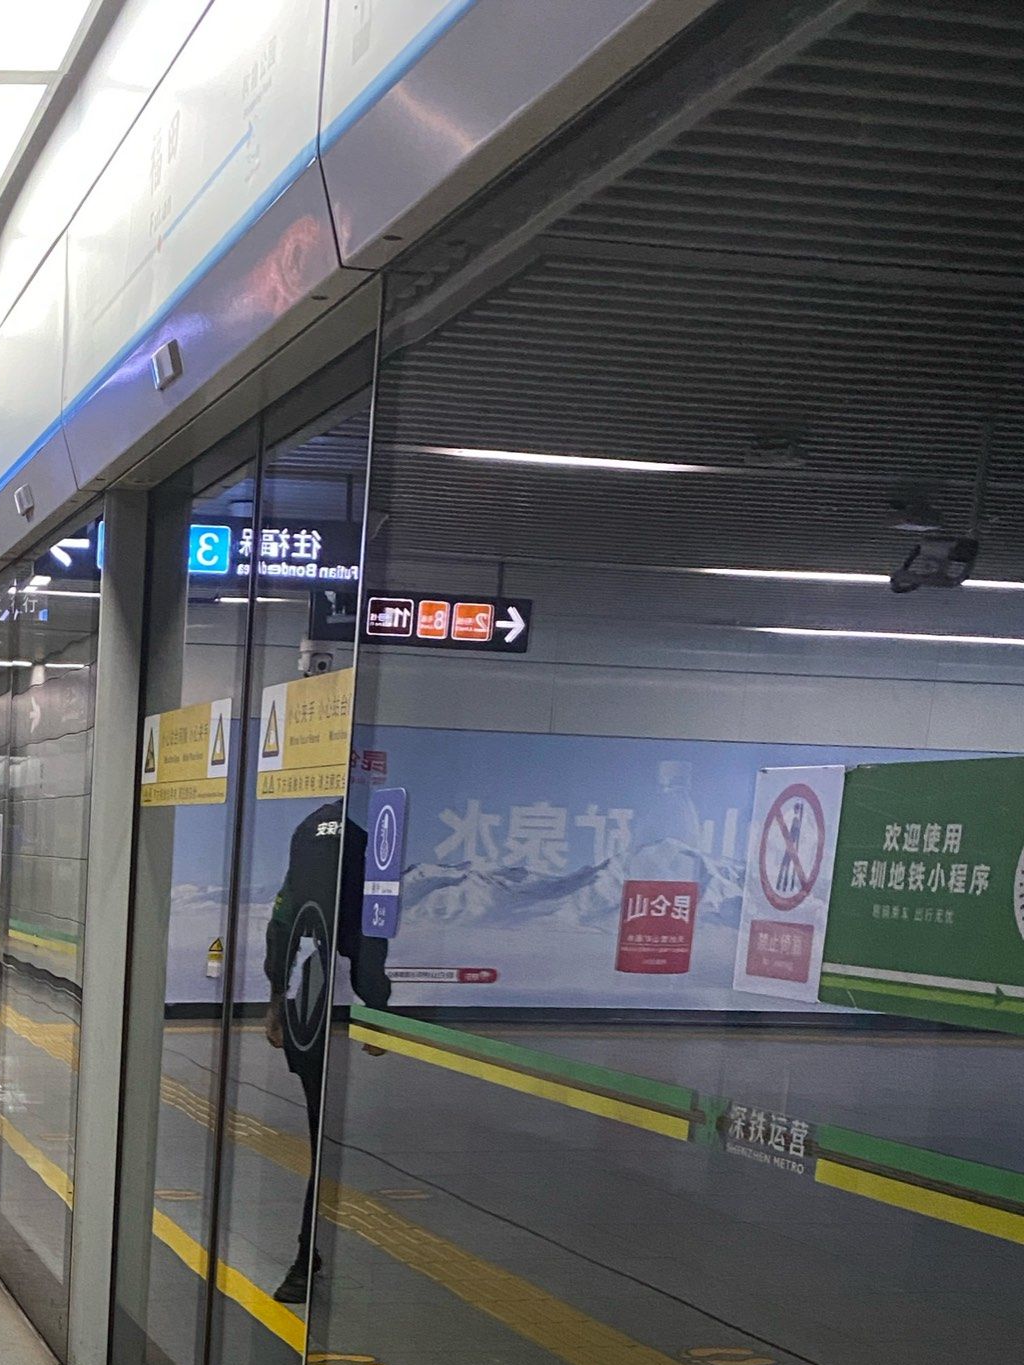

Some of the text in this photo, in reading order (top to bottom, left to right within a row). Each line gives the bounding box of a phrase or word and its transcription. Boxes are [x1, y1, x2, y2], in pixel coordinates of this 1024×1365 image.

[883, 822, 963, 855] 欢迎使用
[850, 859, 992, 896] 深圳地铁小程序
[772, 1155, 805, 1175] METRO
